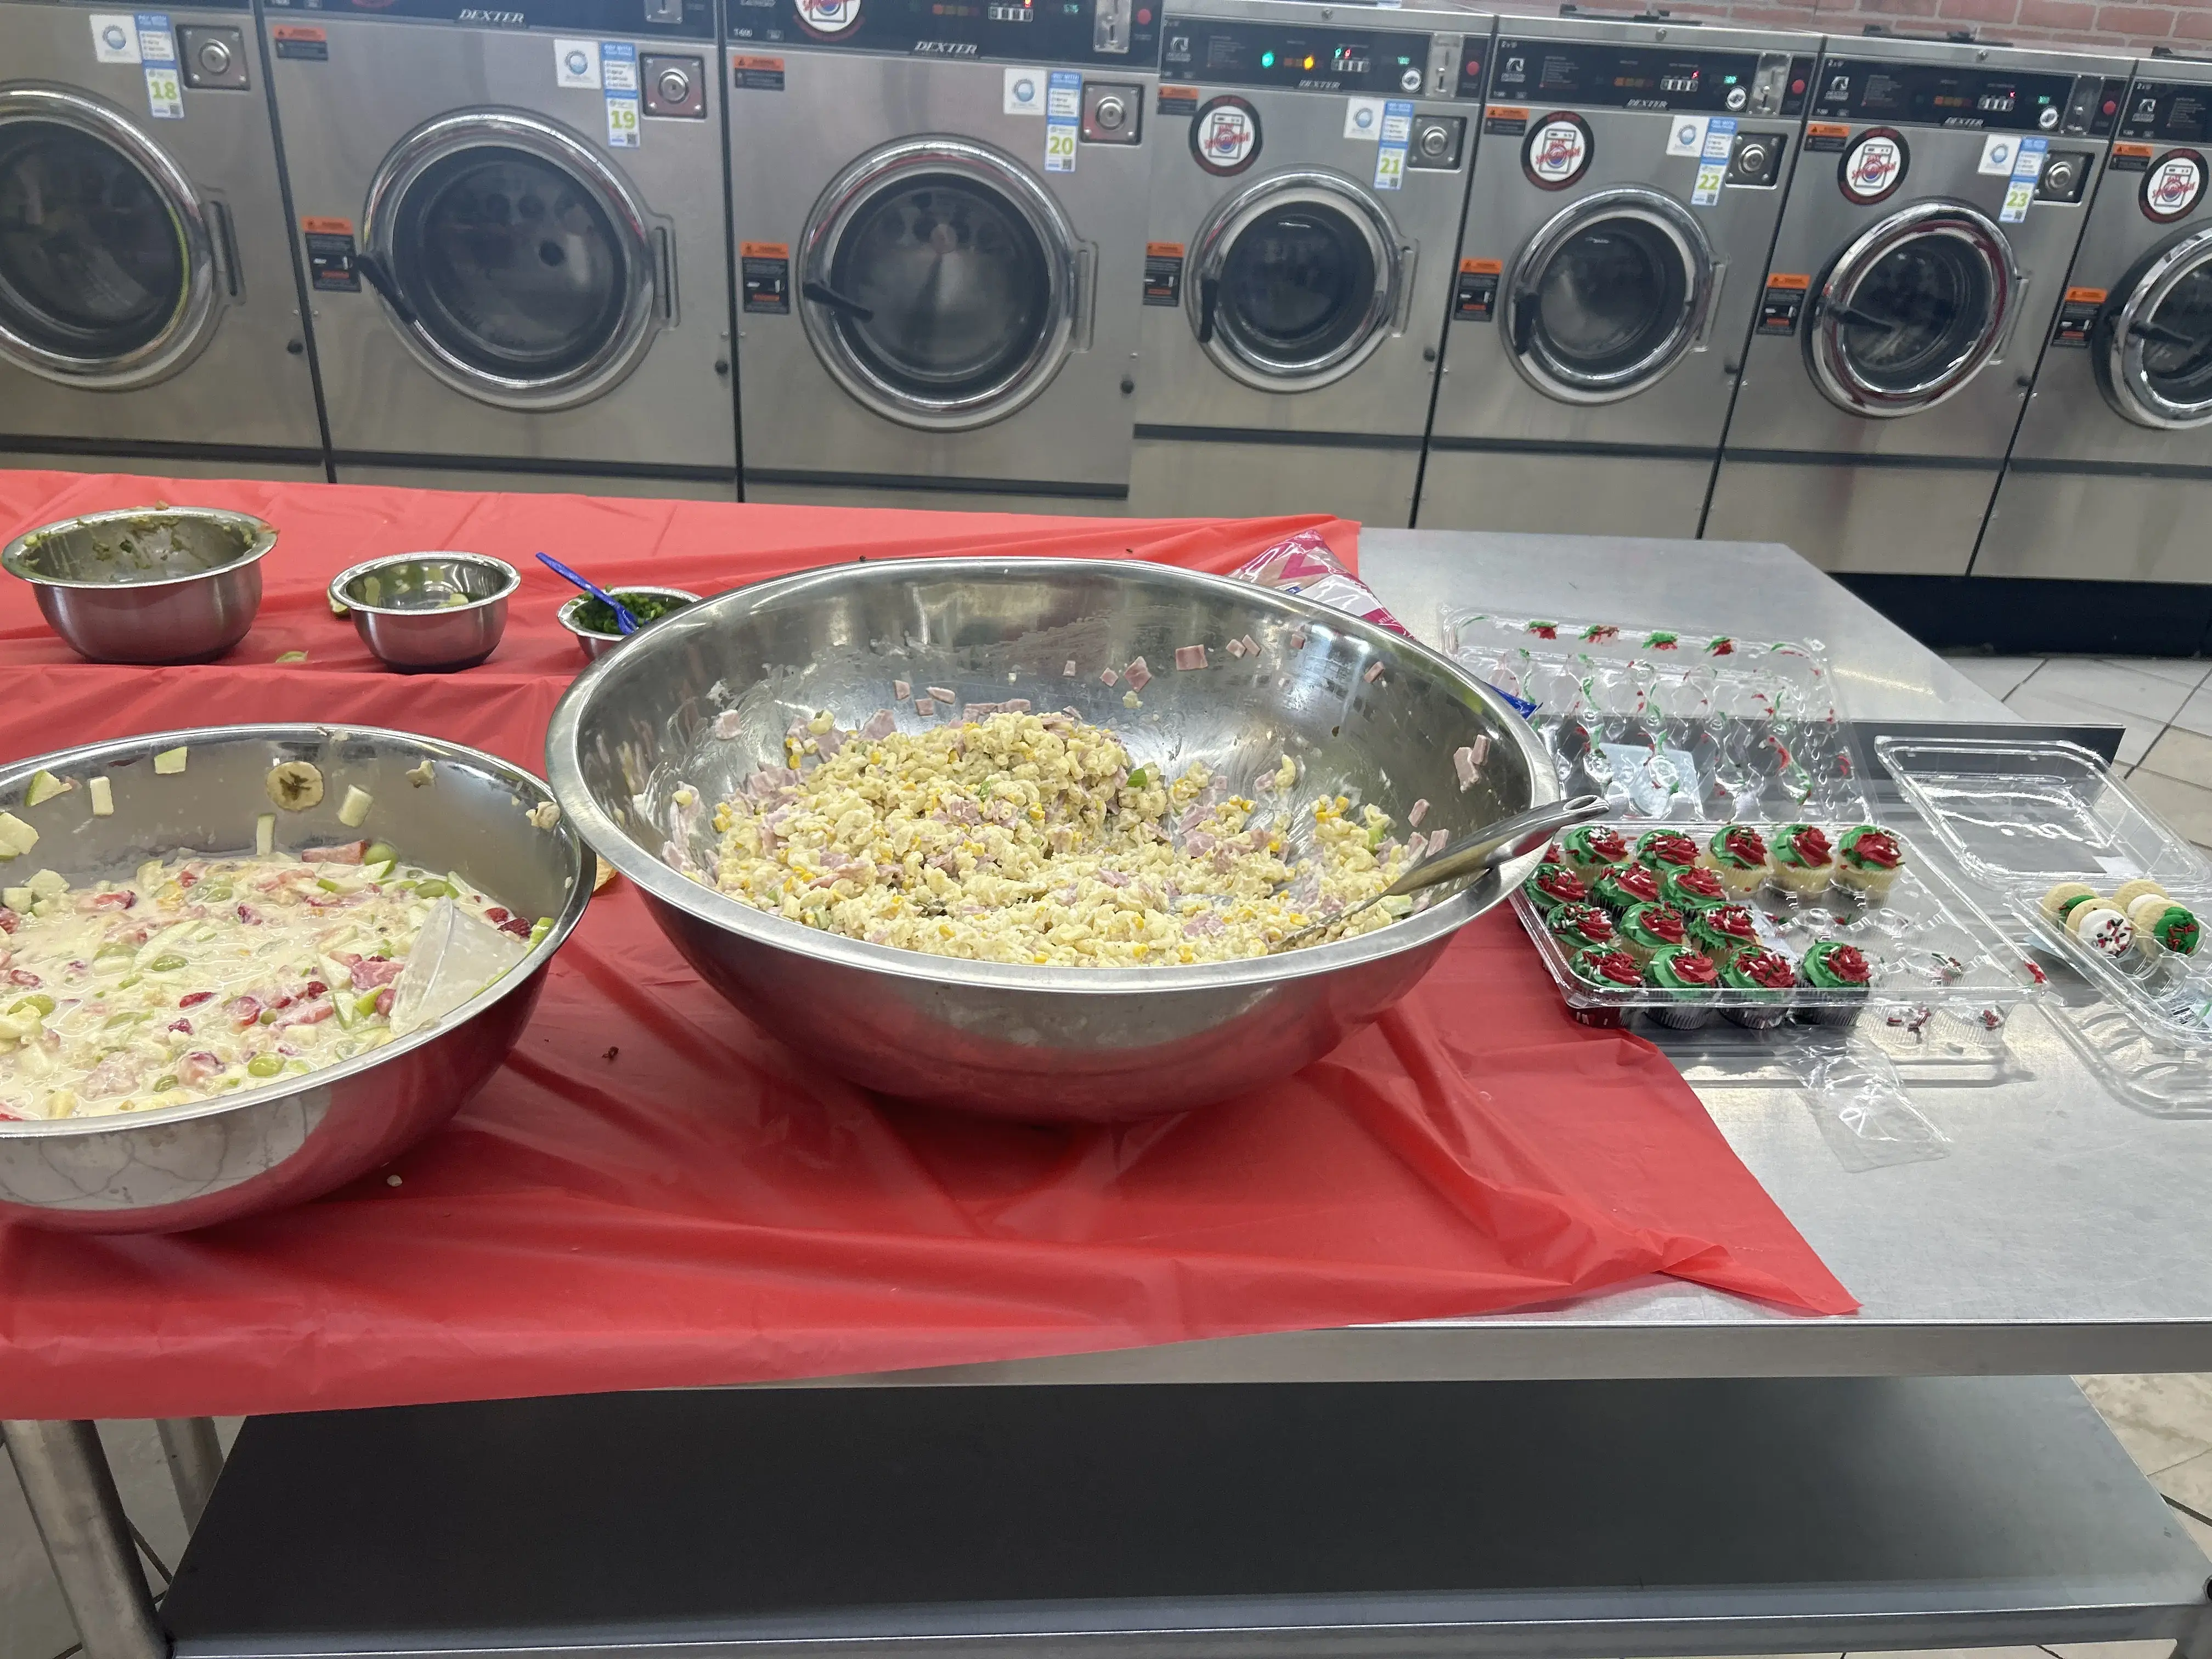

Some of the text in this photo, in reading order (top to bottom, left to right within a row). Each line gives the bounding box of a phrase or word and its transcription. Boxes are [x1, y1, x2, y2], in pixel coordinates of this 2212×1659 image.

[459, 8, 524, 22] DEXTER
[915, 41, 978, 54] DEXTER
[151, 81, 177, 100] 18
[1299, 80, 1341, 88] DEXTER
[1627, 99, 1668, 108] DEXTER
[611, 110, 635, 129] 19
[1945, 117, 1984, 127] DEXTER
[1049, 136, 1073, 155] 20
[1380, 157, 1400, 174] 21
[1698, 174, 1719, 190] 22
[2007, 191, 2028, 207] 23
